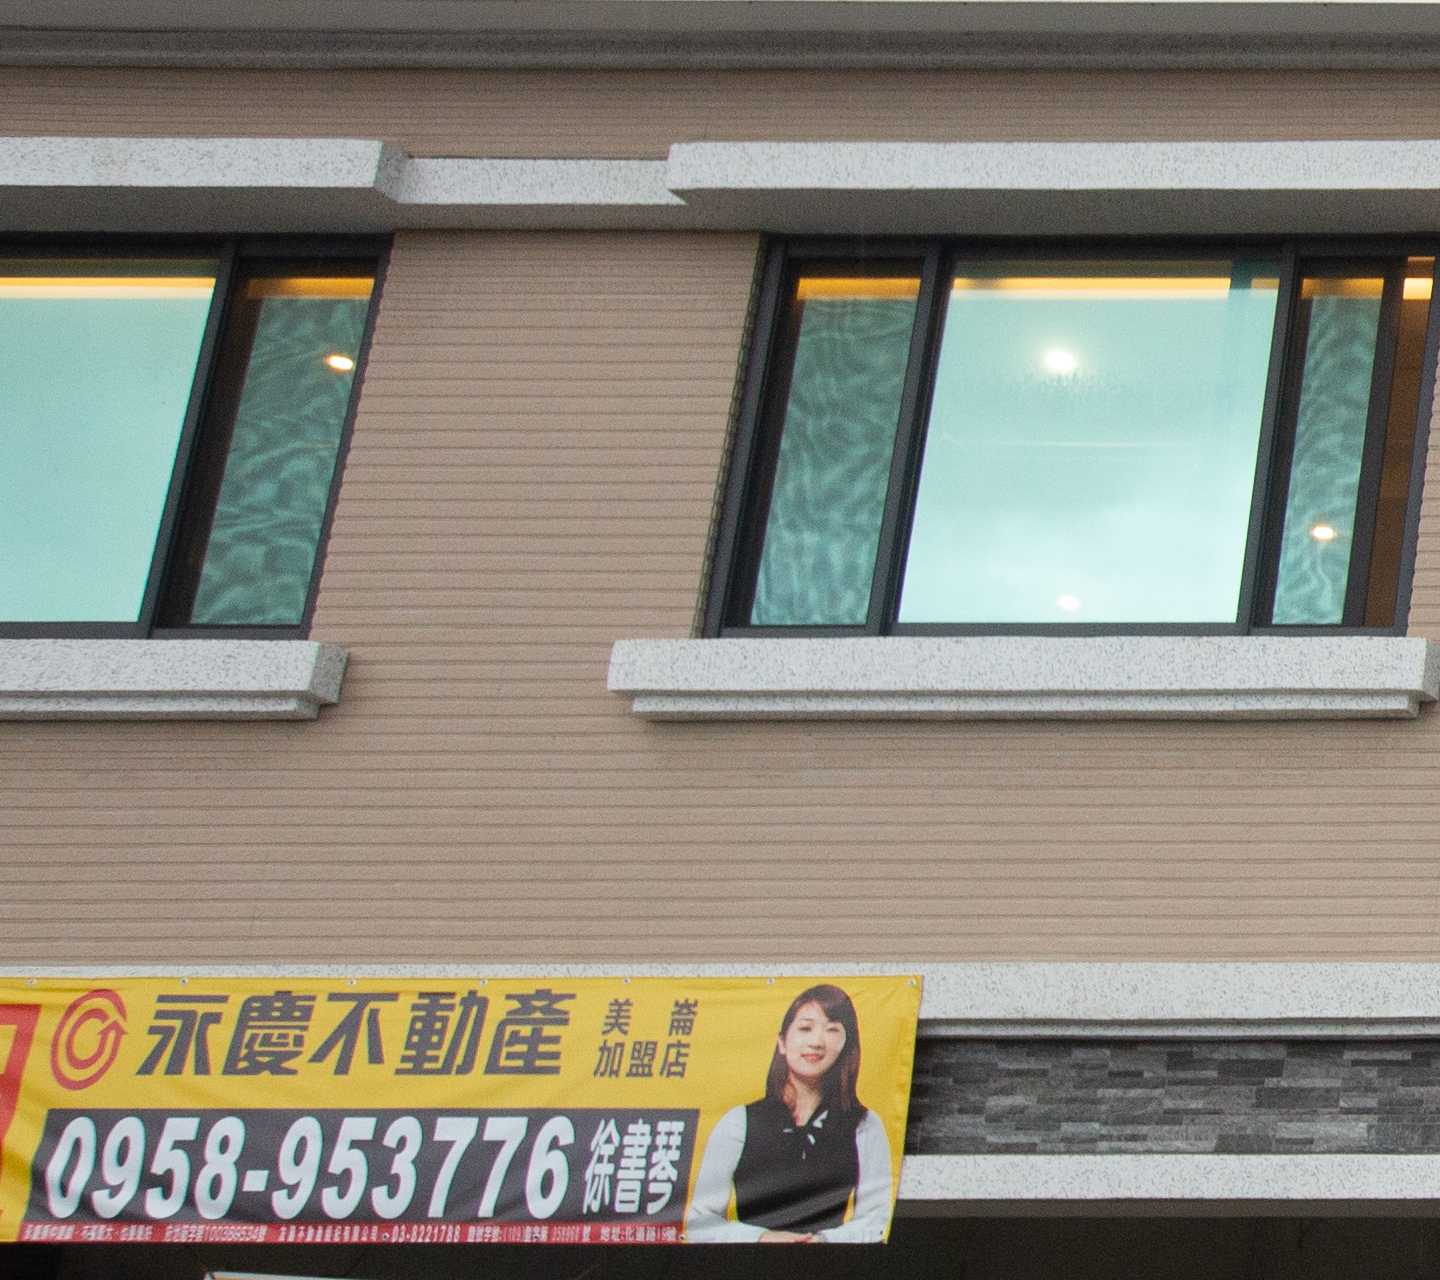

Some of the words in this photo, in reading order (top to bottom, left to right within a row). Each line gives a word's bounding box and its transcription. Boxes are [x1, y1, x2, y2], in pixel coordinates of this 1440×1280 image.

[136, 990, 576, 1077] 永慶不動產
[593, 1040, 690, 1078] 加盟店
[46, 1116, 575, 1219] 0958-953776
[583, 1118, 685, 1216] 徐書琴
